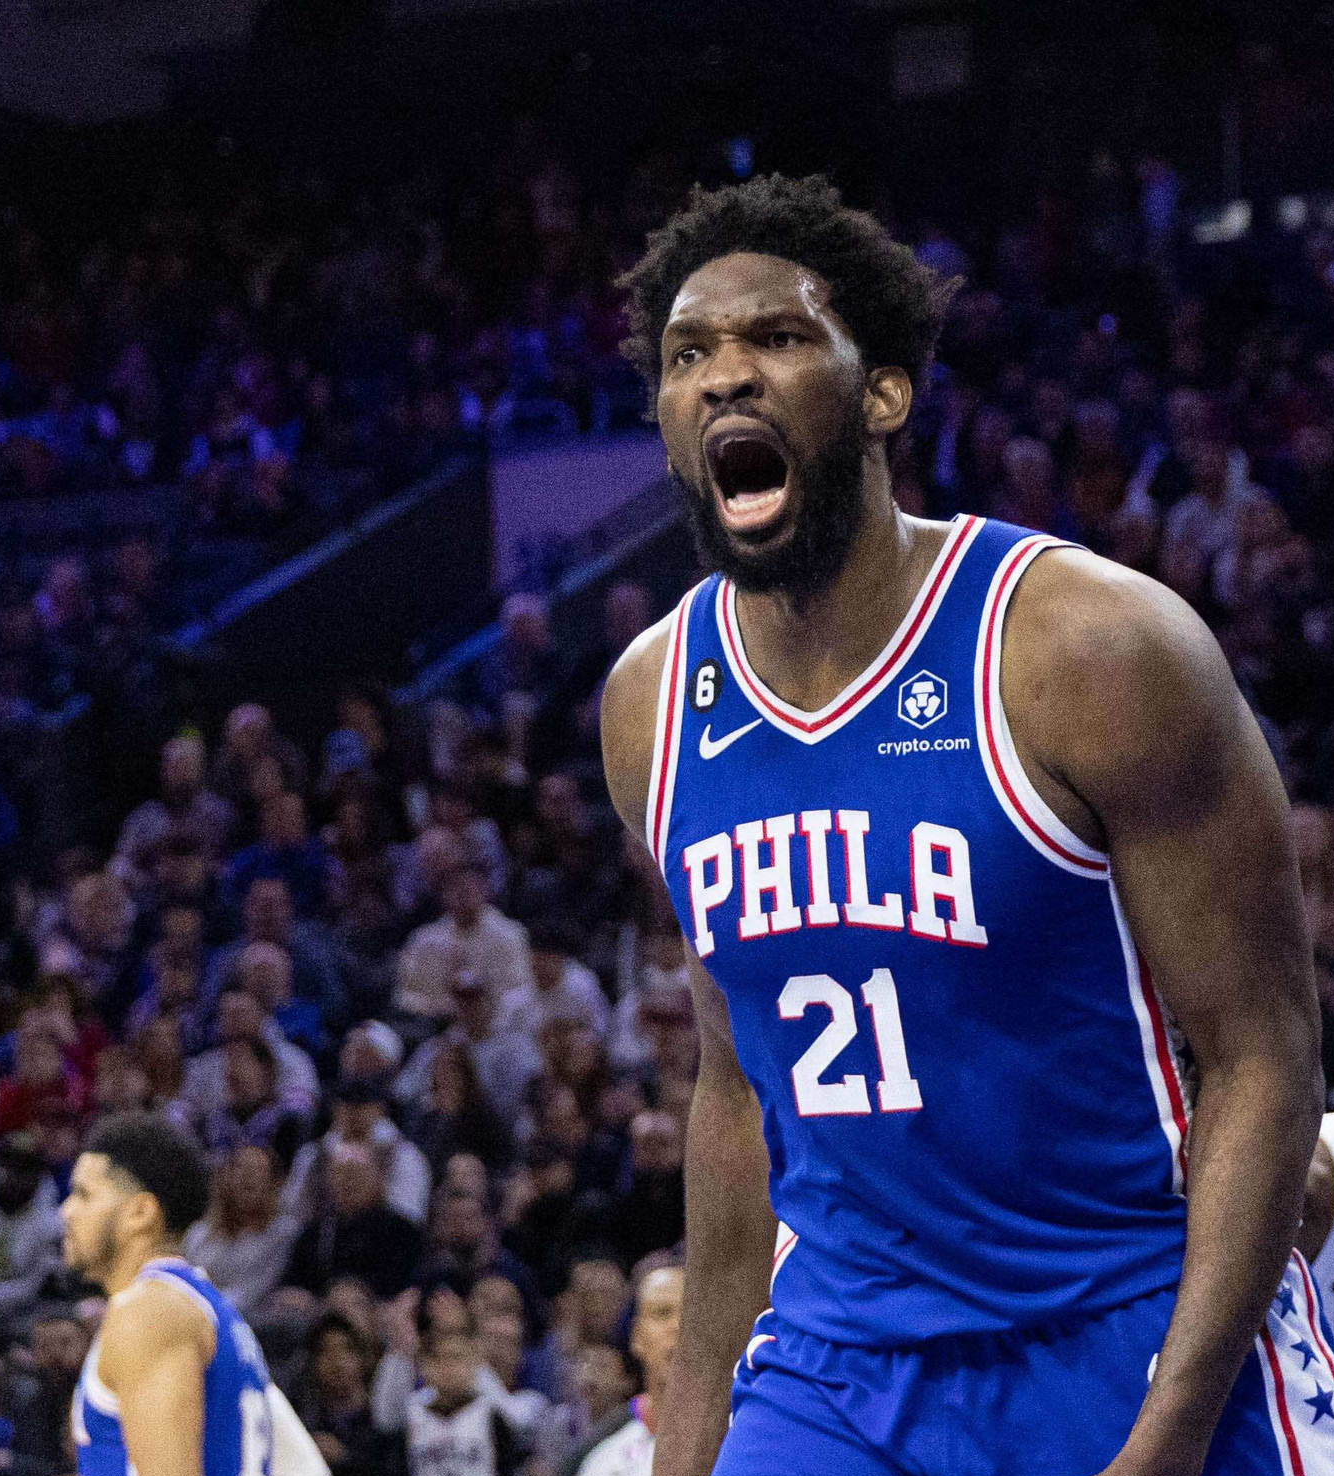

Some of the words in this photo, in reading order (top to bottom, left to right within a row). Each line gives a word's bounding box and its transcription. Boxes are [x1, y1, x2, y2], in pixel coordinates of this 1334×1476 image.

[695, 664, 716, 707] 6
[878, 735, 971, 757] crypto.com
[682, 808, 989, 959] PHILA
[777, 967, 924, 1118] 21
